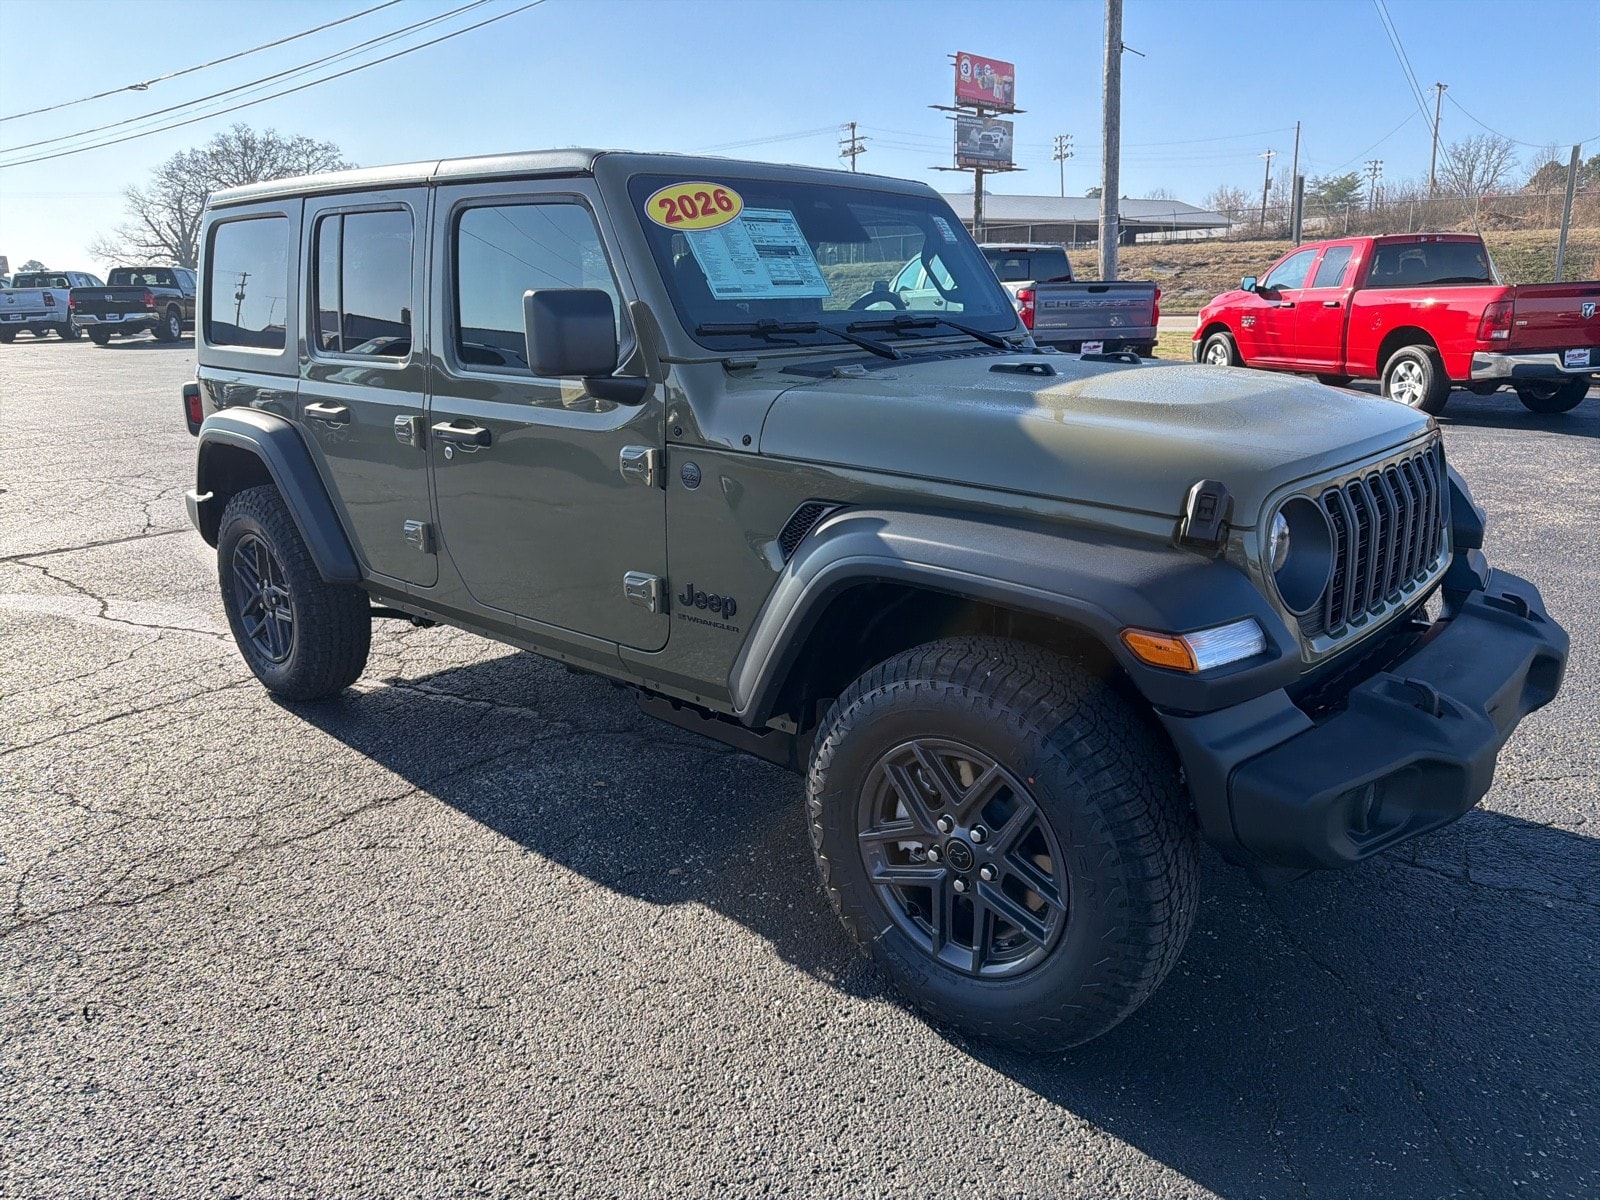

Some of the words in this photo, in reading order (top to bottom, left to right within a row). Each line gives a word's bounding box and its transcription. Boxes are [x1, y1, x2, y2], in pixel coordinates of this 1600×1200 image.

[658, 188, 734, 224] 2026
[678, 582, 737, 620] Jeep
[686, 615, 740, 633] WRANGLER
